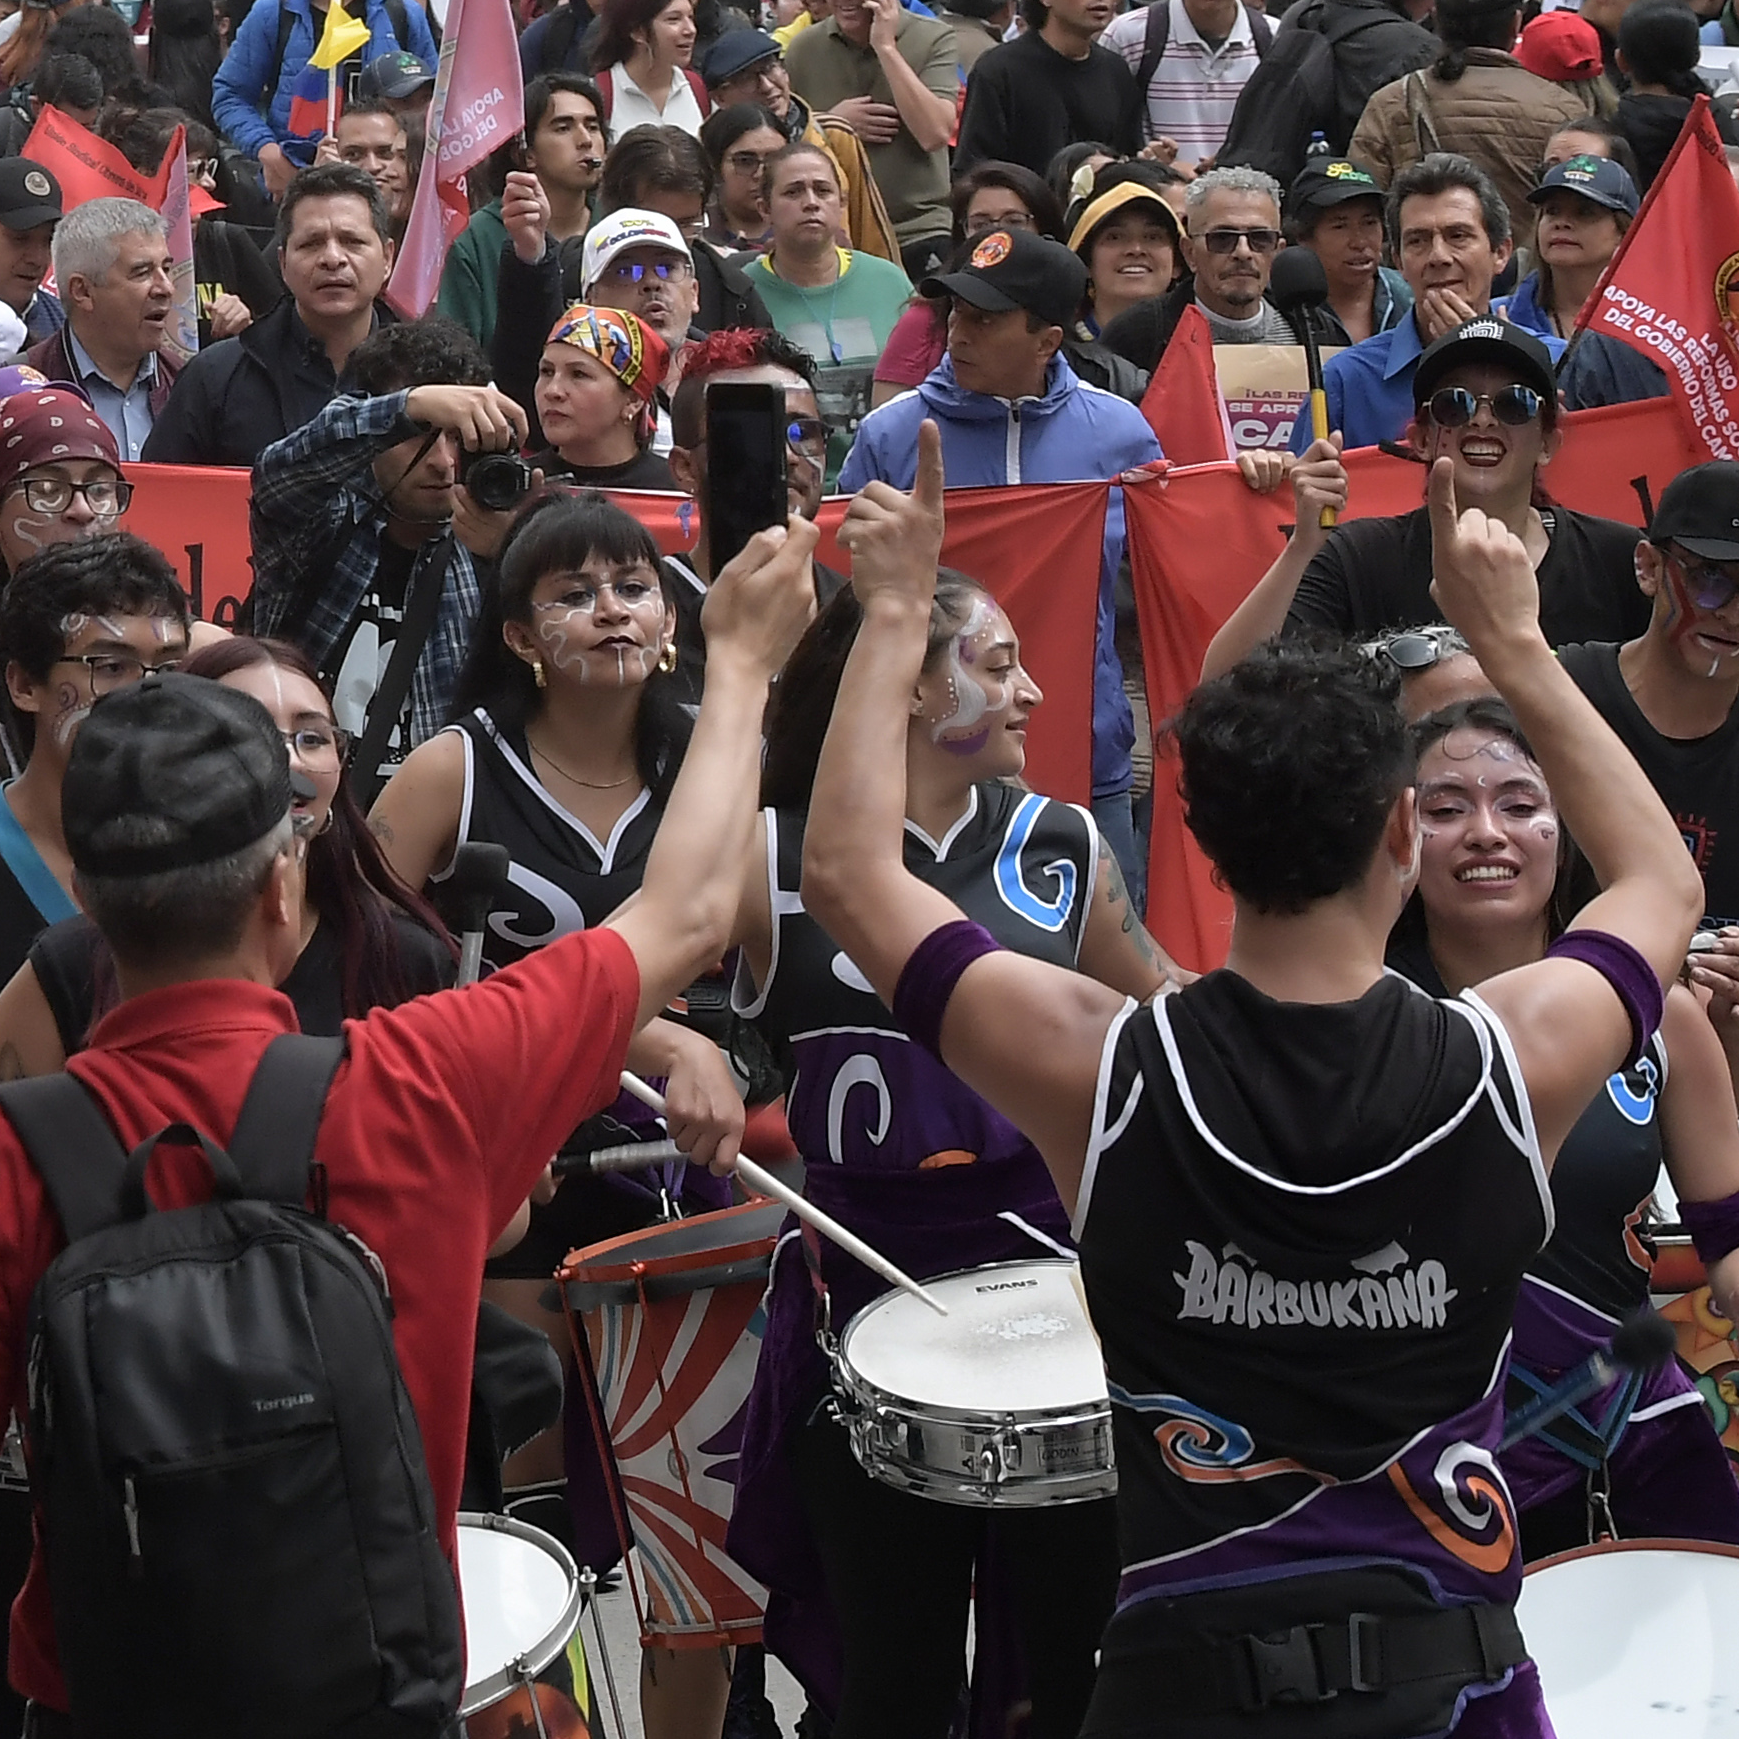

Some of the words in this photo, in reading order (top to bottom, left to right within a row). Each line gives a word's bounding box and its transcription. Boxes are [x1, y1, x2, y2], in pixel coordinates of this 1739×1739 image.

[1603, 285, 1656, 323] APOYA
[1654, 312, 1688, 342] LAS
[1683, 333, 1730, 427] REFORMAS
[1603, 306, 1634, 337] DEL
[1634, 322, 1701, 397] GOBIERNO
[1688, 392, 1711, 429] DEL
[1701, 332, 1719, 358] LA
[1714, 352, 1738, 392] USO
[1229, 401, 1251, 414] SE
[975, 1279, 1039, 1294] EVANS
[1172, 1240, 1459, 1331] BARBUKANA
[252, 1392, 316, 1413] Targus
